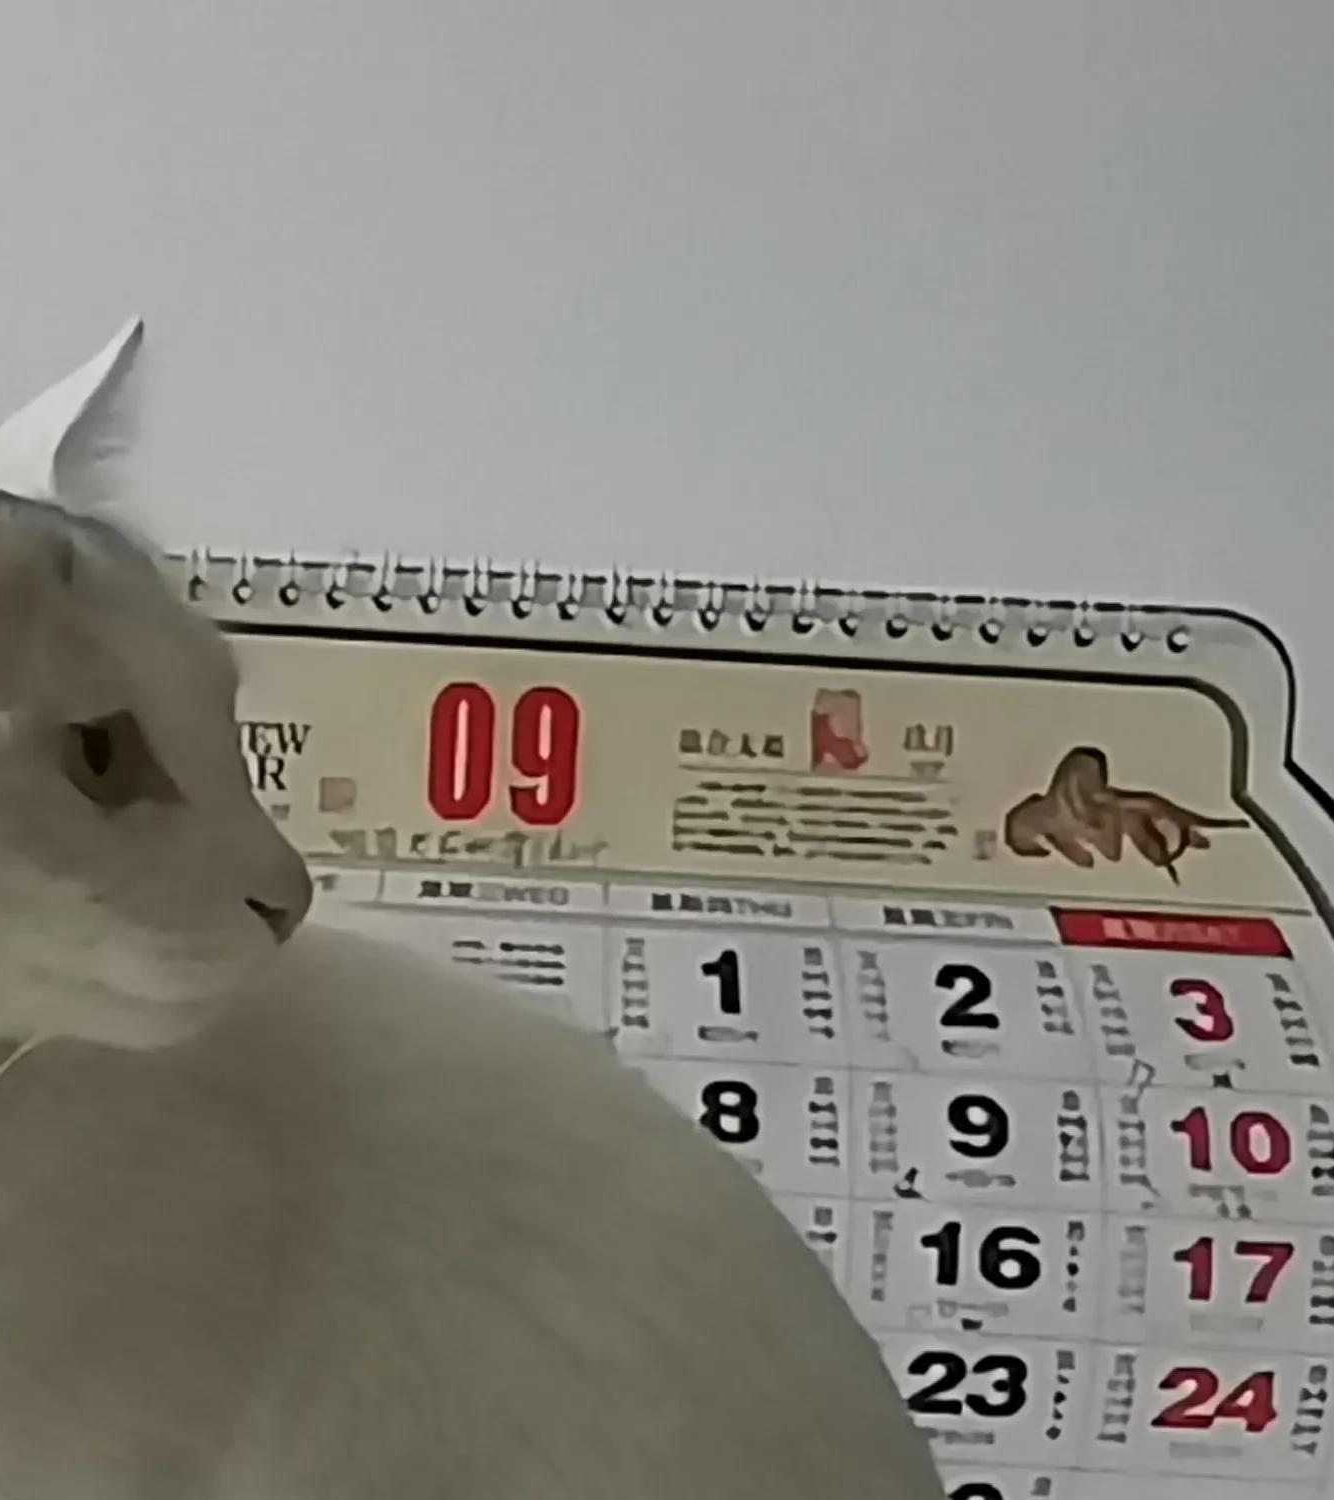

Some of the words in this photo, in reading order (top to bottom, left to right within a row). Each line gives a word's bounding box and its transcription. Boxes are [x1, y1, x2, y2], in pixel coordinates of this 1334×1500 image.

[245, 721, 312, 756] EW
[427, 681, 581, 826] 09
[701, 949, 742, 1015] 1
[934, 963, 1000, 1030] 2
[1169, 978, 1234, 1042] 3
[700, 1080, 760, 1144] 8
[947, 1094, 1009, 1158] 9
[1170, 1106, 1291, 1175] 10
[920, 1221, 1041, 1290] 16
[1173, 1236, 1295, 1303] 17
[907, 1350, 1028, 1418] 23
[1150, 1366, 1278, 1434] 24
